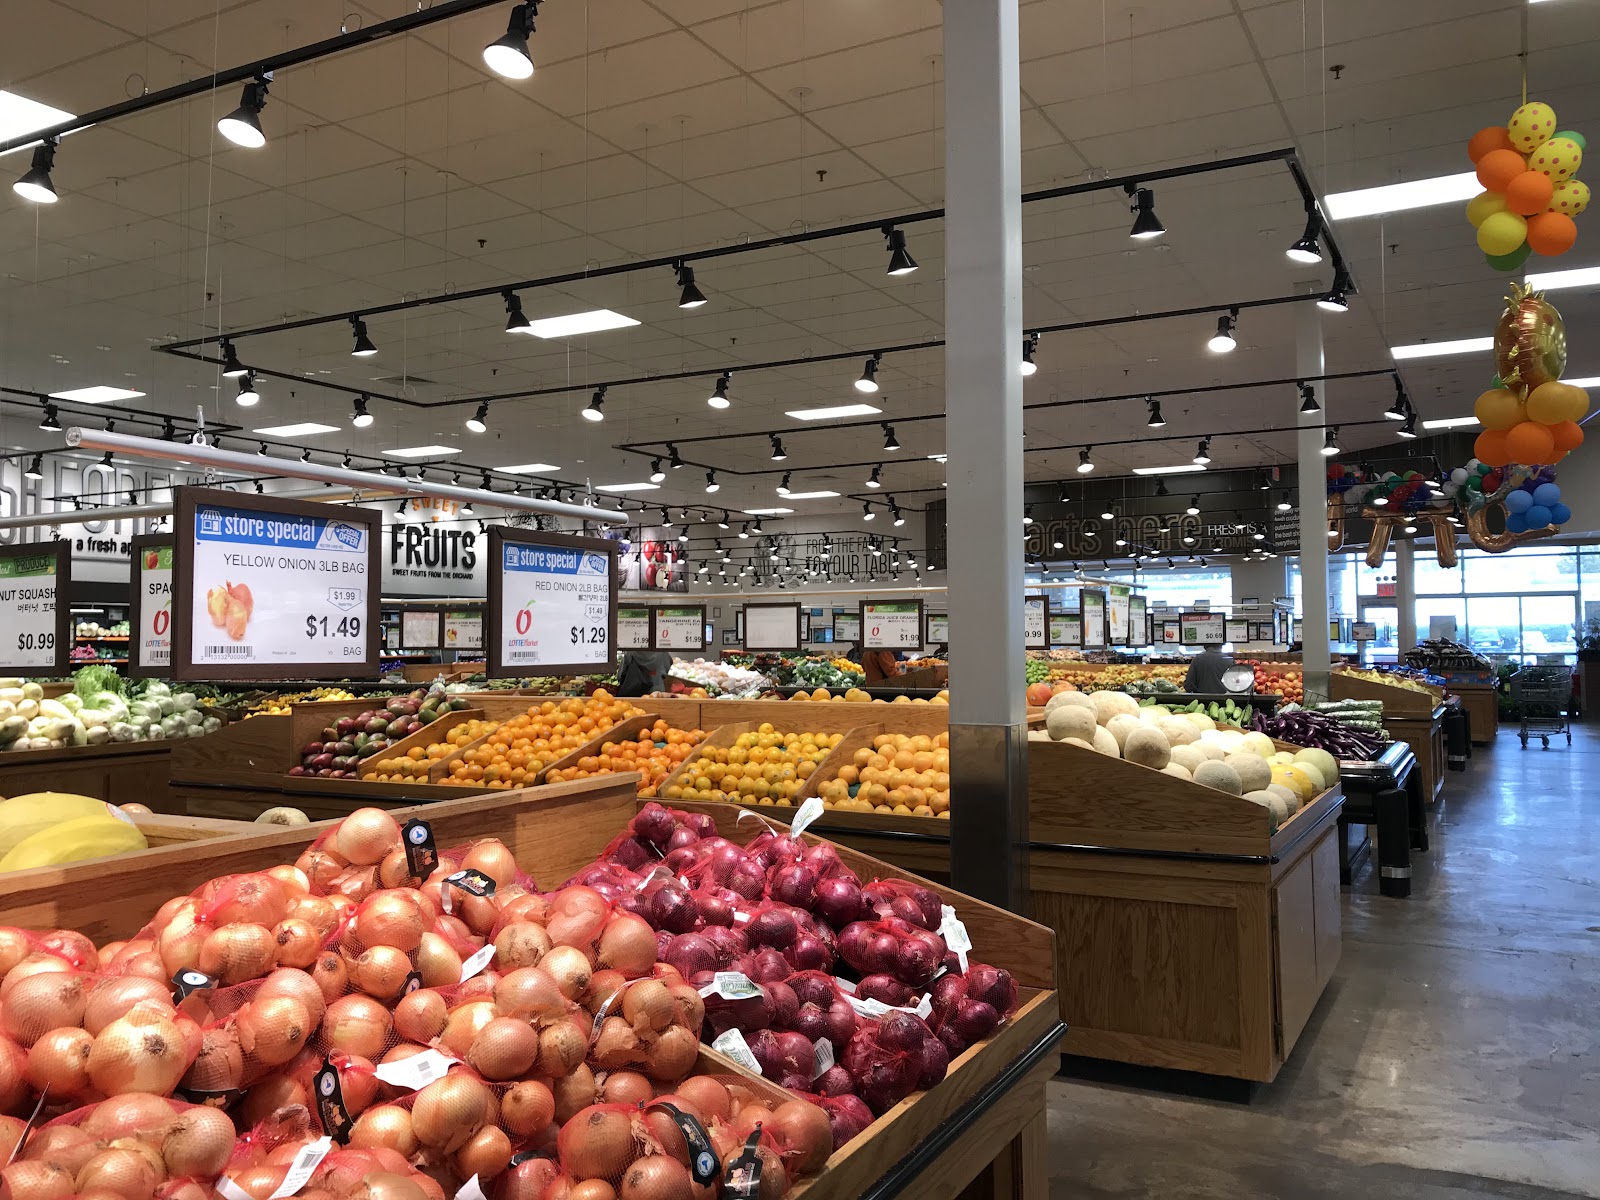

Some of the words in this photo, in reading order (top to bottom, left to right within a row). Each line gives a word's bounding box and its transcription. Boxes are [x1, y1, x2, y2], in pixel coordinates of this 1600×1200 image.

[411, 496, 459, 515] SWEET
[224, 513, 264, 537] store
[267, 518, 315, 544] special
[340, 524, 360, 540] SPECIAL
[1112, 505, 1202, 554] here
[1207, 522, 1243, 535] FRESH
[1246, 521, 1257, 534] IS
[76, 540, 83, 551] a
[88, 537, 117, 553] fresh
[339, 532, 359, 549] OFFER
[391, 523, 476, 570] FRUITS
[837, 537, 854, 553] THE
[857, 535, 885, 552] FAM
[1208, 535, 1257, 549] PROMIS
[15, 555, 48, 571] PRODUCE
[223, 553, 276, 568] YELLOW
[278, 557, 316, 571] ONION
[319, 560, 339, 572] 3LB
[342, 561, 365, 574] BAG
[520, 548, 544, 567] store
[546, 552, 577, 571] special
[826, 554, 859, 576] YOUR
[391, 568, 409, 576] SWEET
[410, 569, 427, 578] FRUITS
[428, 570, 441, 578] FROM
[442, 571, 451, 579] THE
[452, 572, 474, 580] ORCHARD
[19, 587, 57, 600] SQUASH
[535, 580, 551, 591] RED
[554, 581, 577, 592] ONION
[579, 583, 591, 593] 2LB
[593, 584, 608, 593] BAG
[1378, 584, 1395, 596] EXIT
[333, 590, 356, 601] $1.99
[305, 613, 361, 640] $1.49
[17, 632, 55, 652] $0.99
[570, 625, 606, 646] $1.29
[899, 633, 919, 642] $1.99
[343, 646, 362, 656] BAG
[594, 650, 607, 659] BAG
[45, 656, 54, 664] LB
